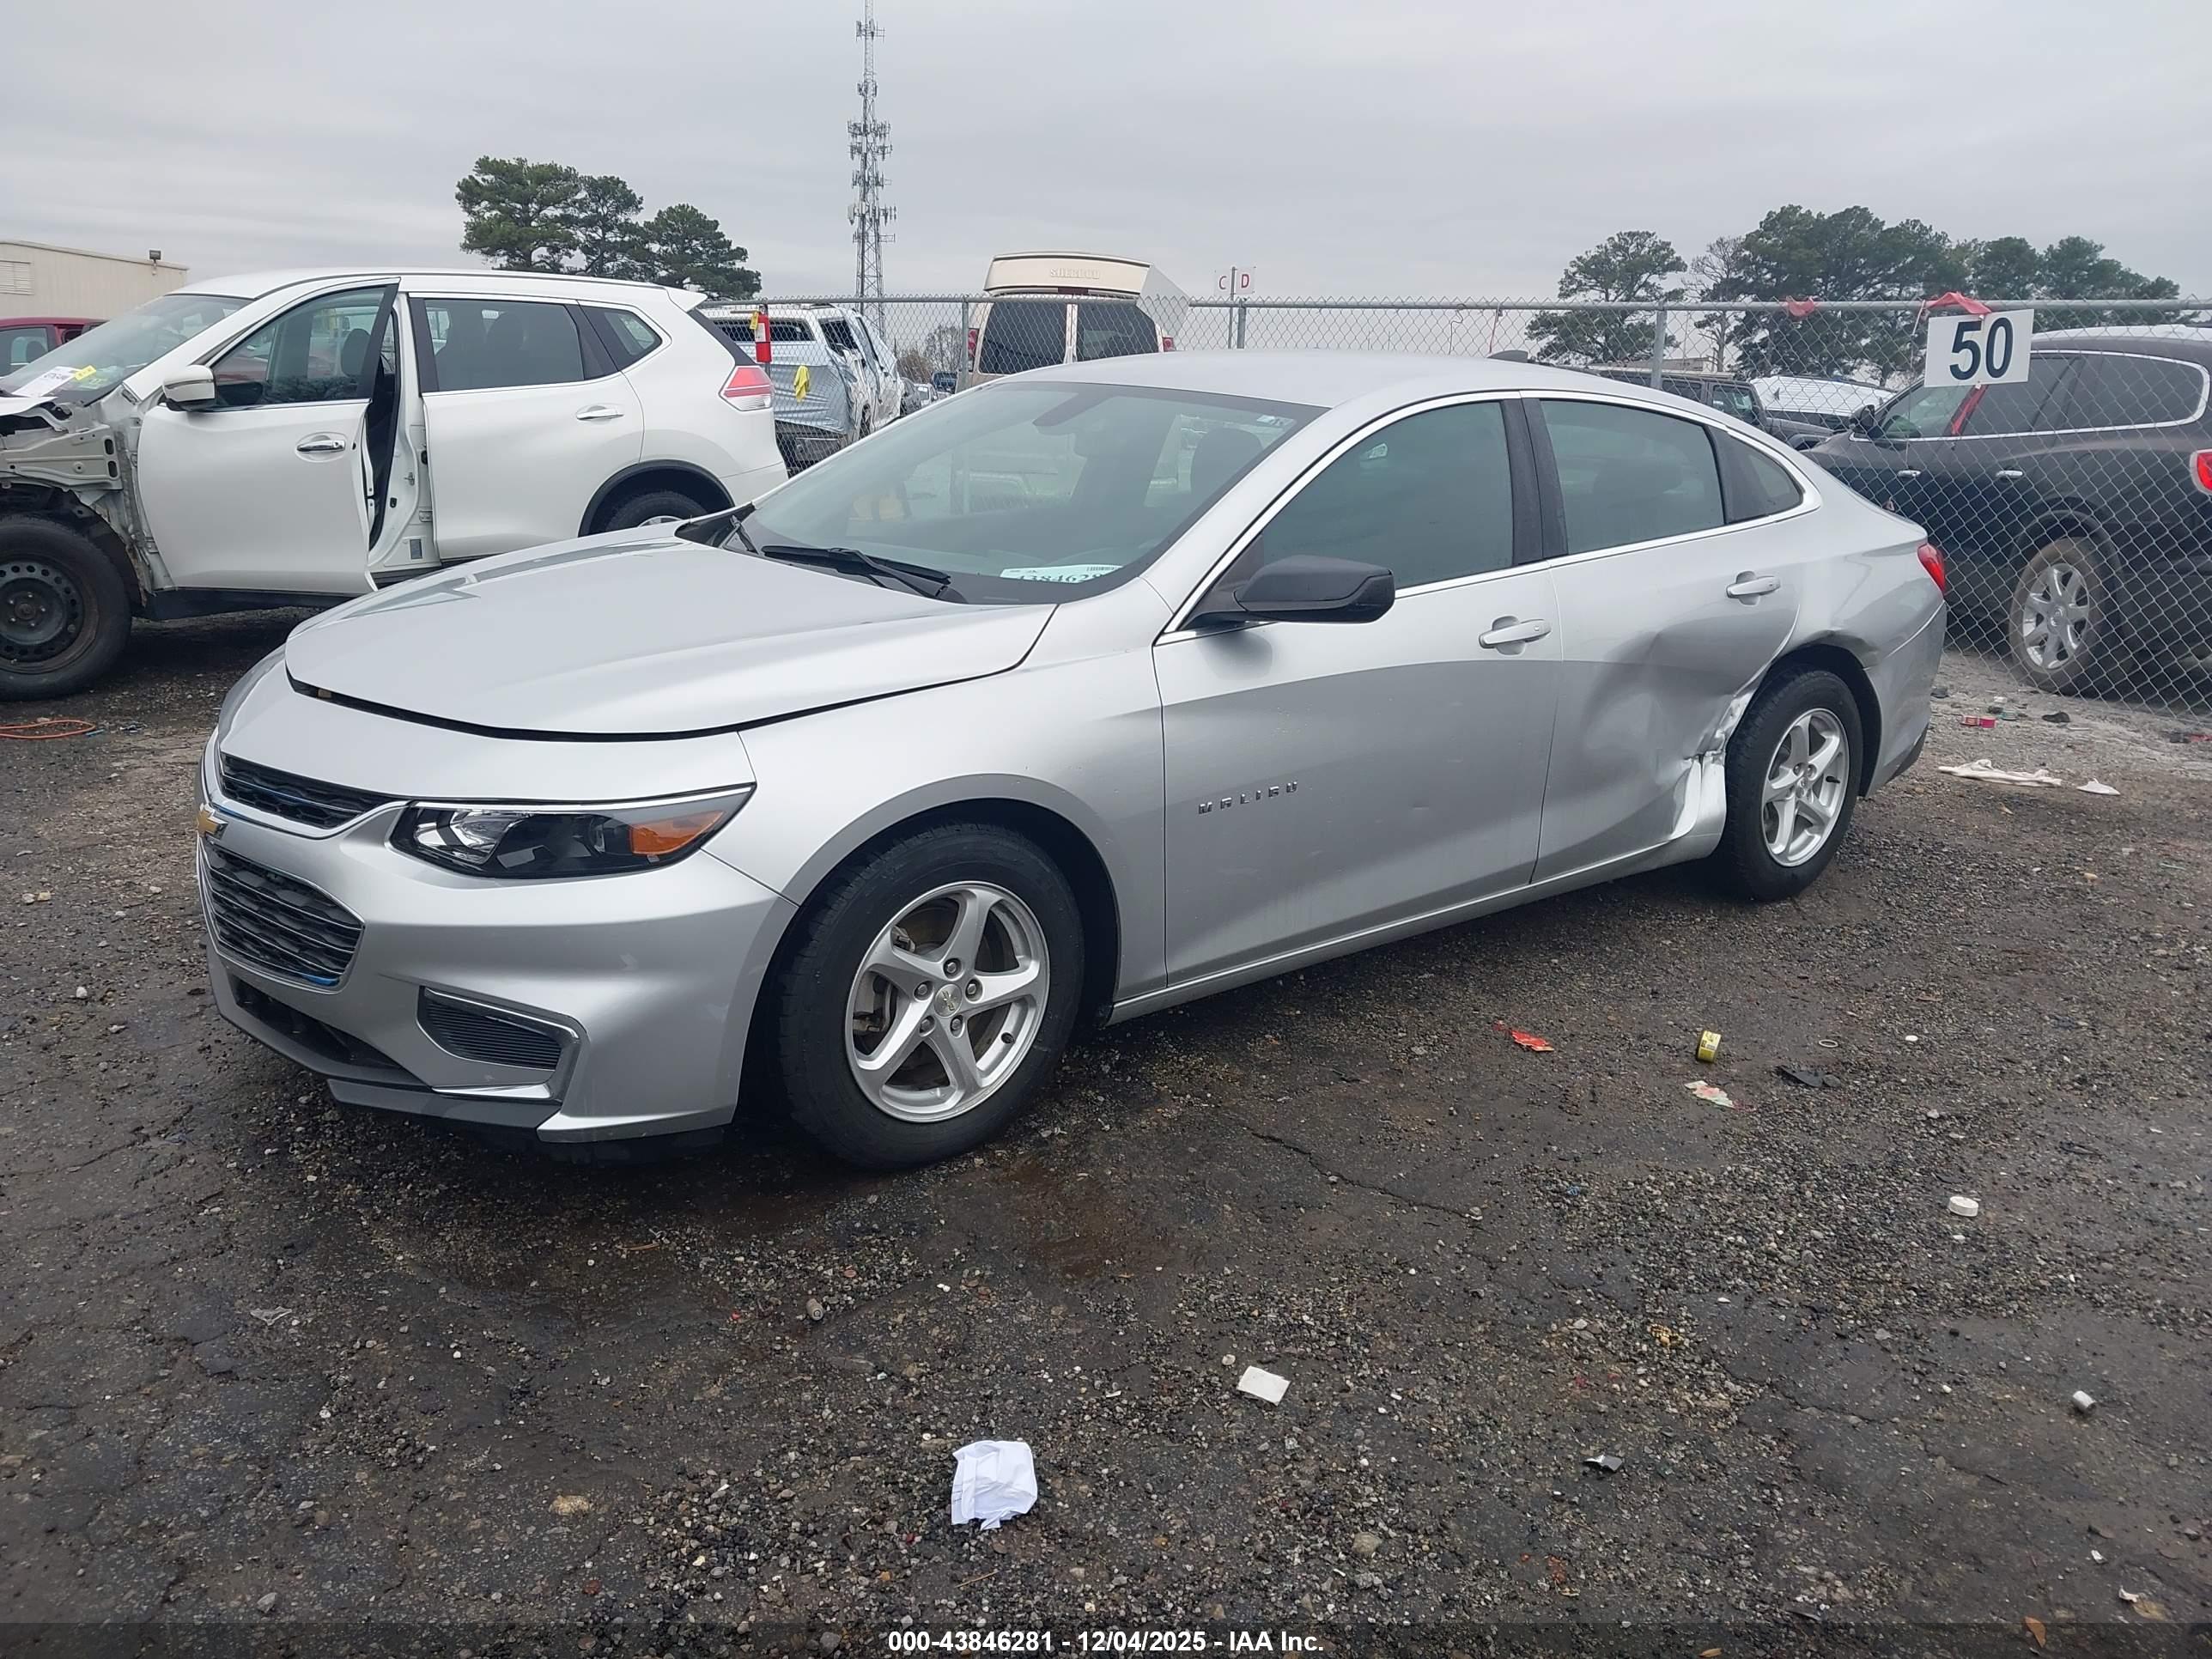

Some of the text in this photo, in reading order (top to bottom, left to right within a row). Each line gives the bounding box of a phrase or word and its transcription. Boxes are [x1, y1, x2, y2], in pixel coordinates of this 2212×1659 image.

[1219, 276, 1227, 290] C
[1241, 274, 1249, 289] D
[1949, 317, 2014, 380] 50
[1198, 781, 1298, 814] MALIBU
